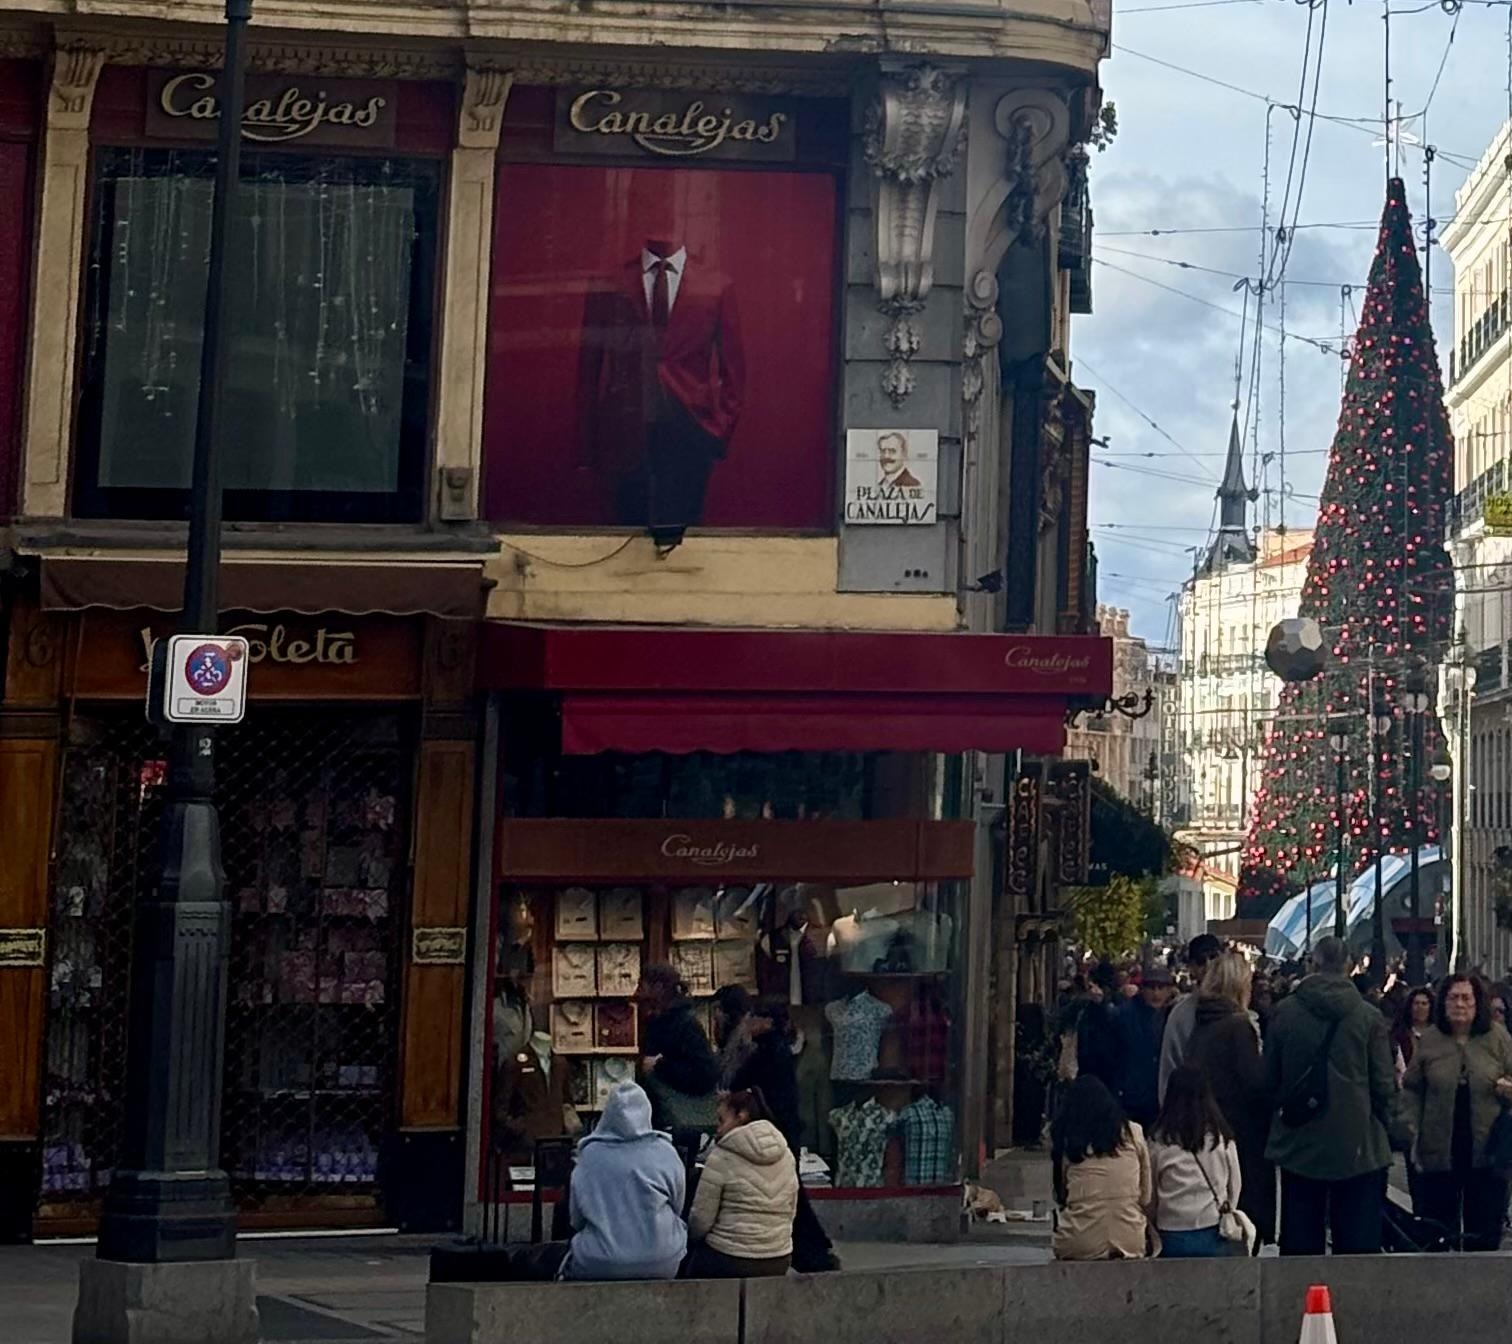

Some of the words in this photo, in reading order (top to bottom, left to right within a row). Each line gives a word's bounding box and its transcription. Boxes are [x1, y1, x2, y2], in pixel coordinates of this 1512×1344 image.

[161, 73, 386, 142] Caalejas
[570, 90, 787, 155] Canalejas
[856, 485, 906, 501] PLAZA
[908, 488, 924, 500] DE
[847, 501, 935, 524] CANALEJAS
[1004, 646, 1091, 674] Canalejas
[661, 833, 760, 866] Canalejas
